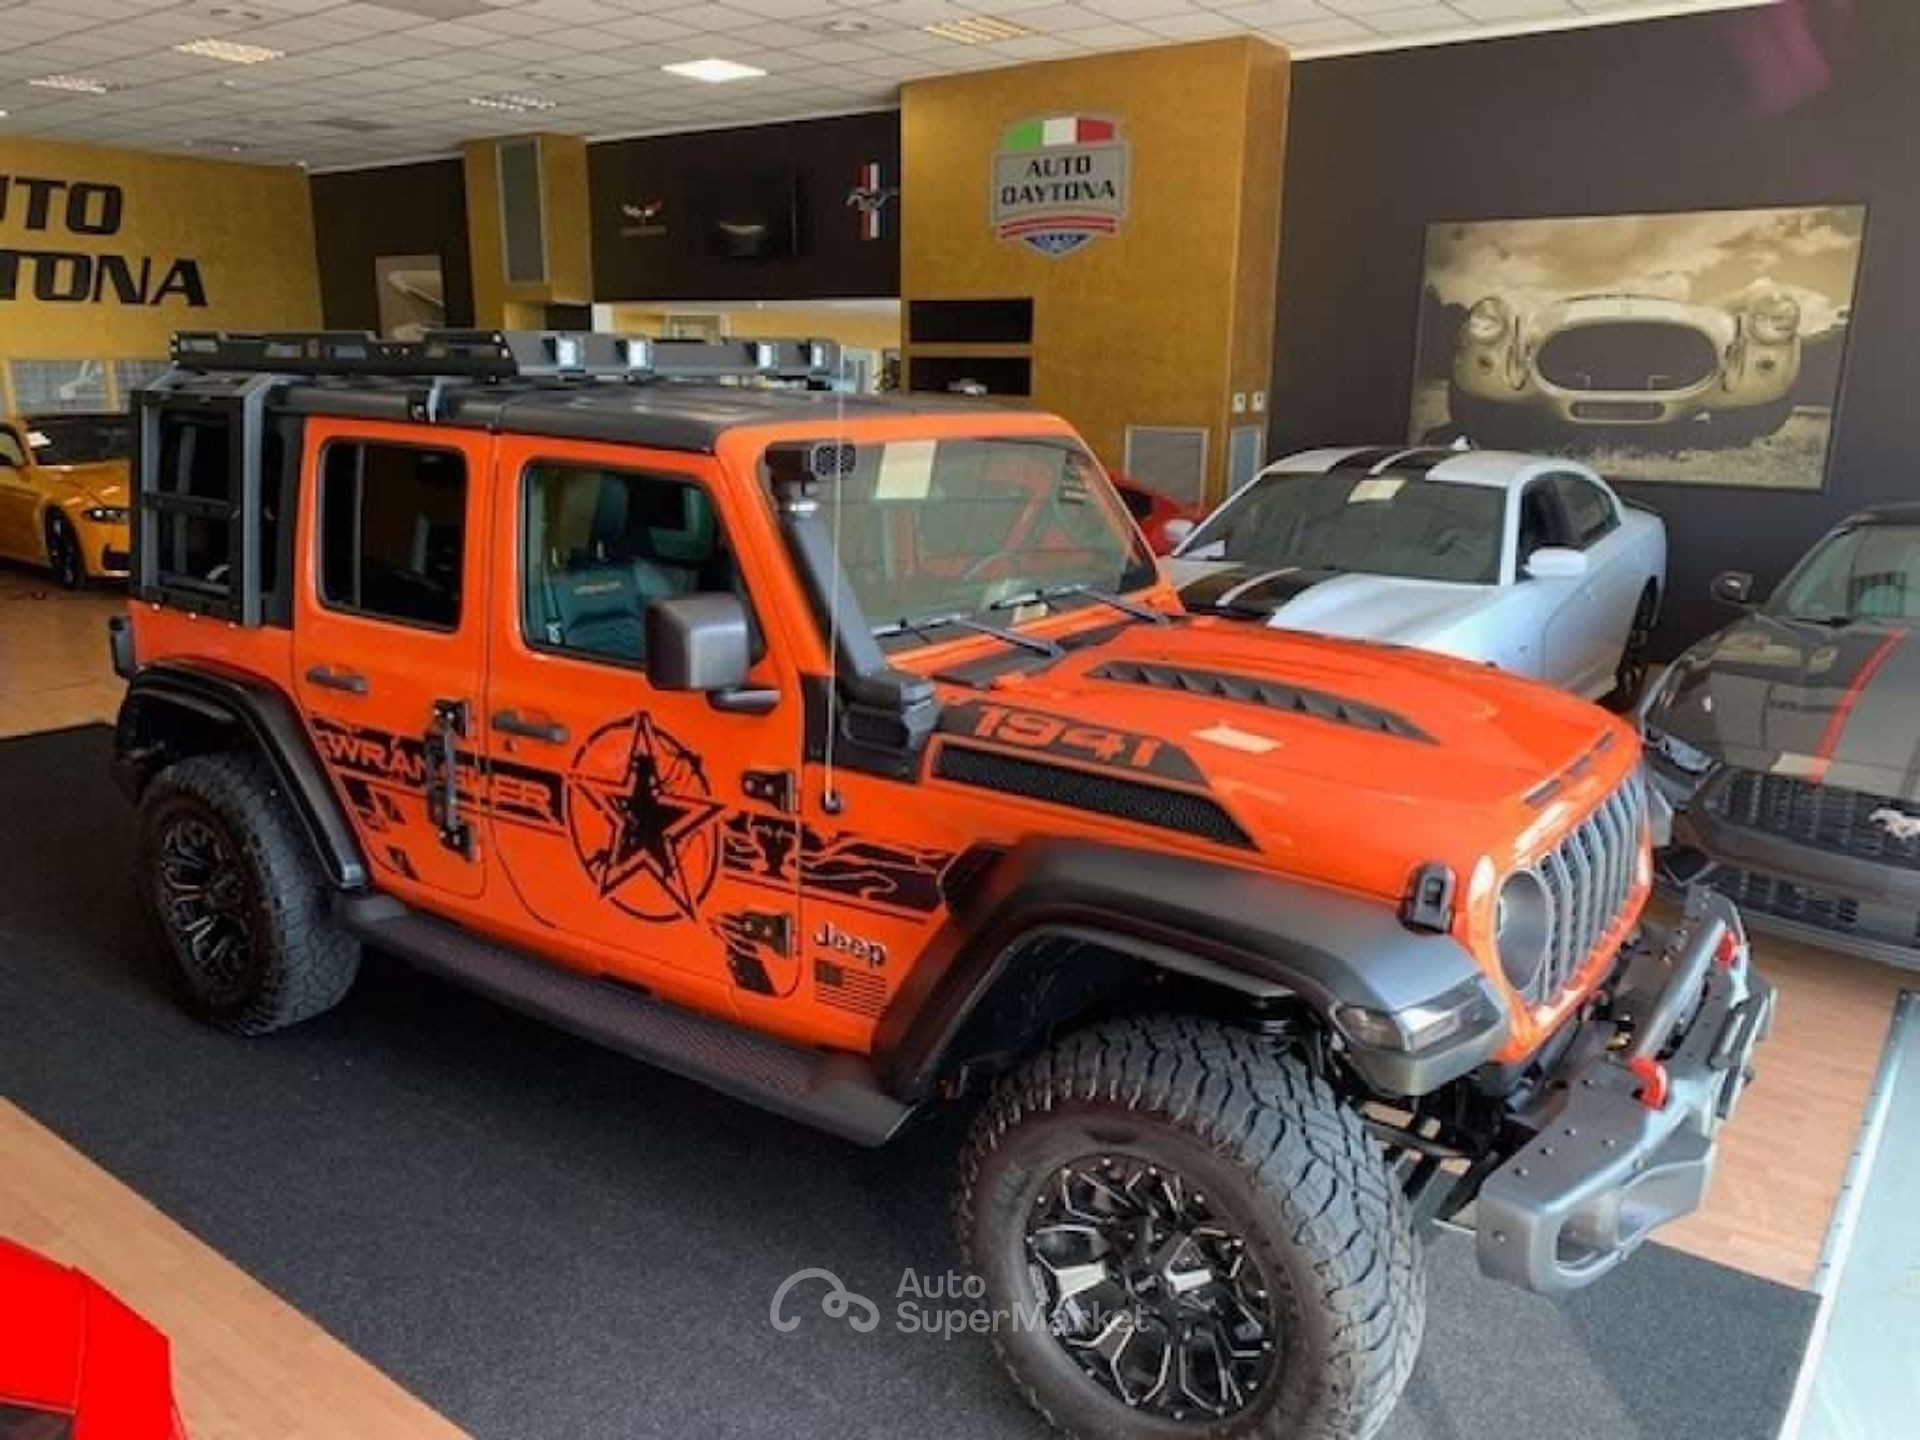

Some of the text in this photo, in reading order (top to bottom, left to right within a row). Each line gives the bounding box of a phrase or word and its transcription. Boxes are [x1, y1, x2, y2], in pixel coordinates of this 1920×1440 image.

[1025, 155, 1091, 178] AUTO
[0, 175, 122, 235] TO
[1002, 180, 1115, 205] DAYTONA
[974, 704, 1161, 768] 1941
[813, 922, 886, 968] Jeep
